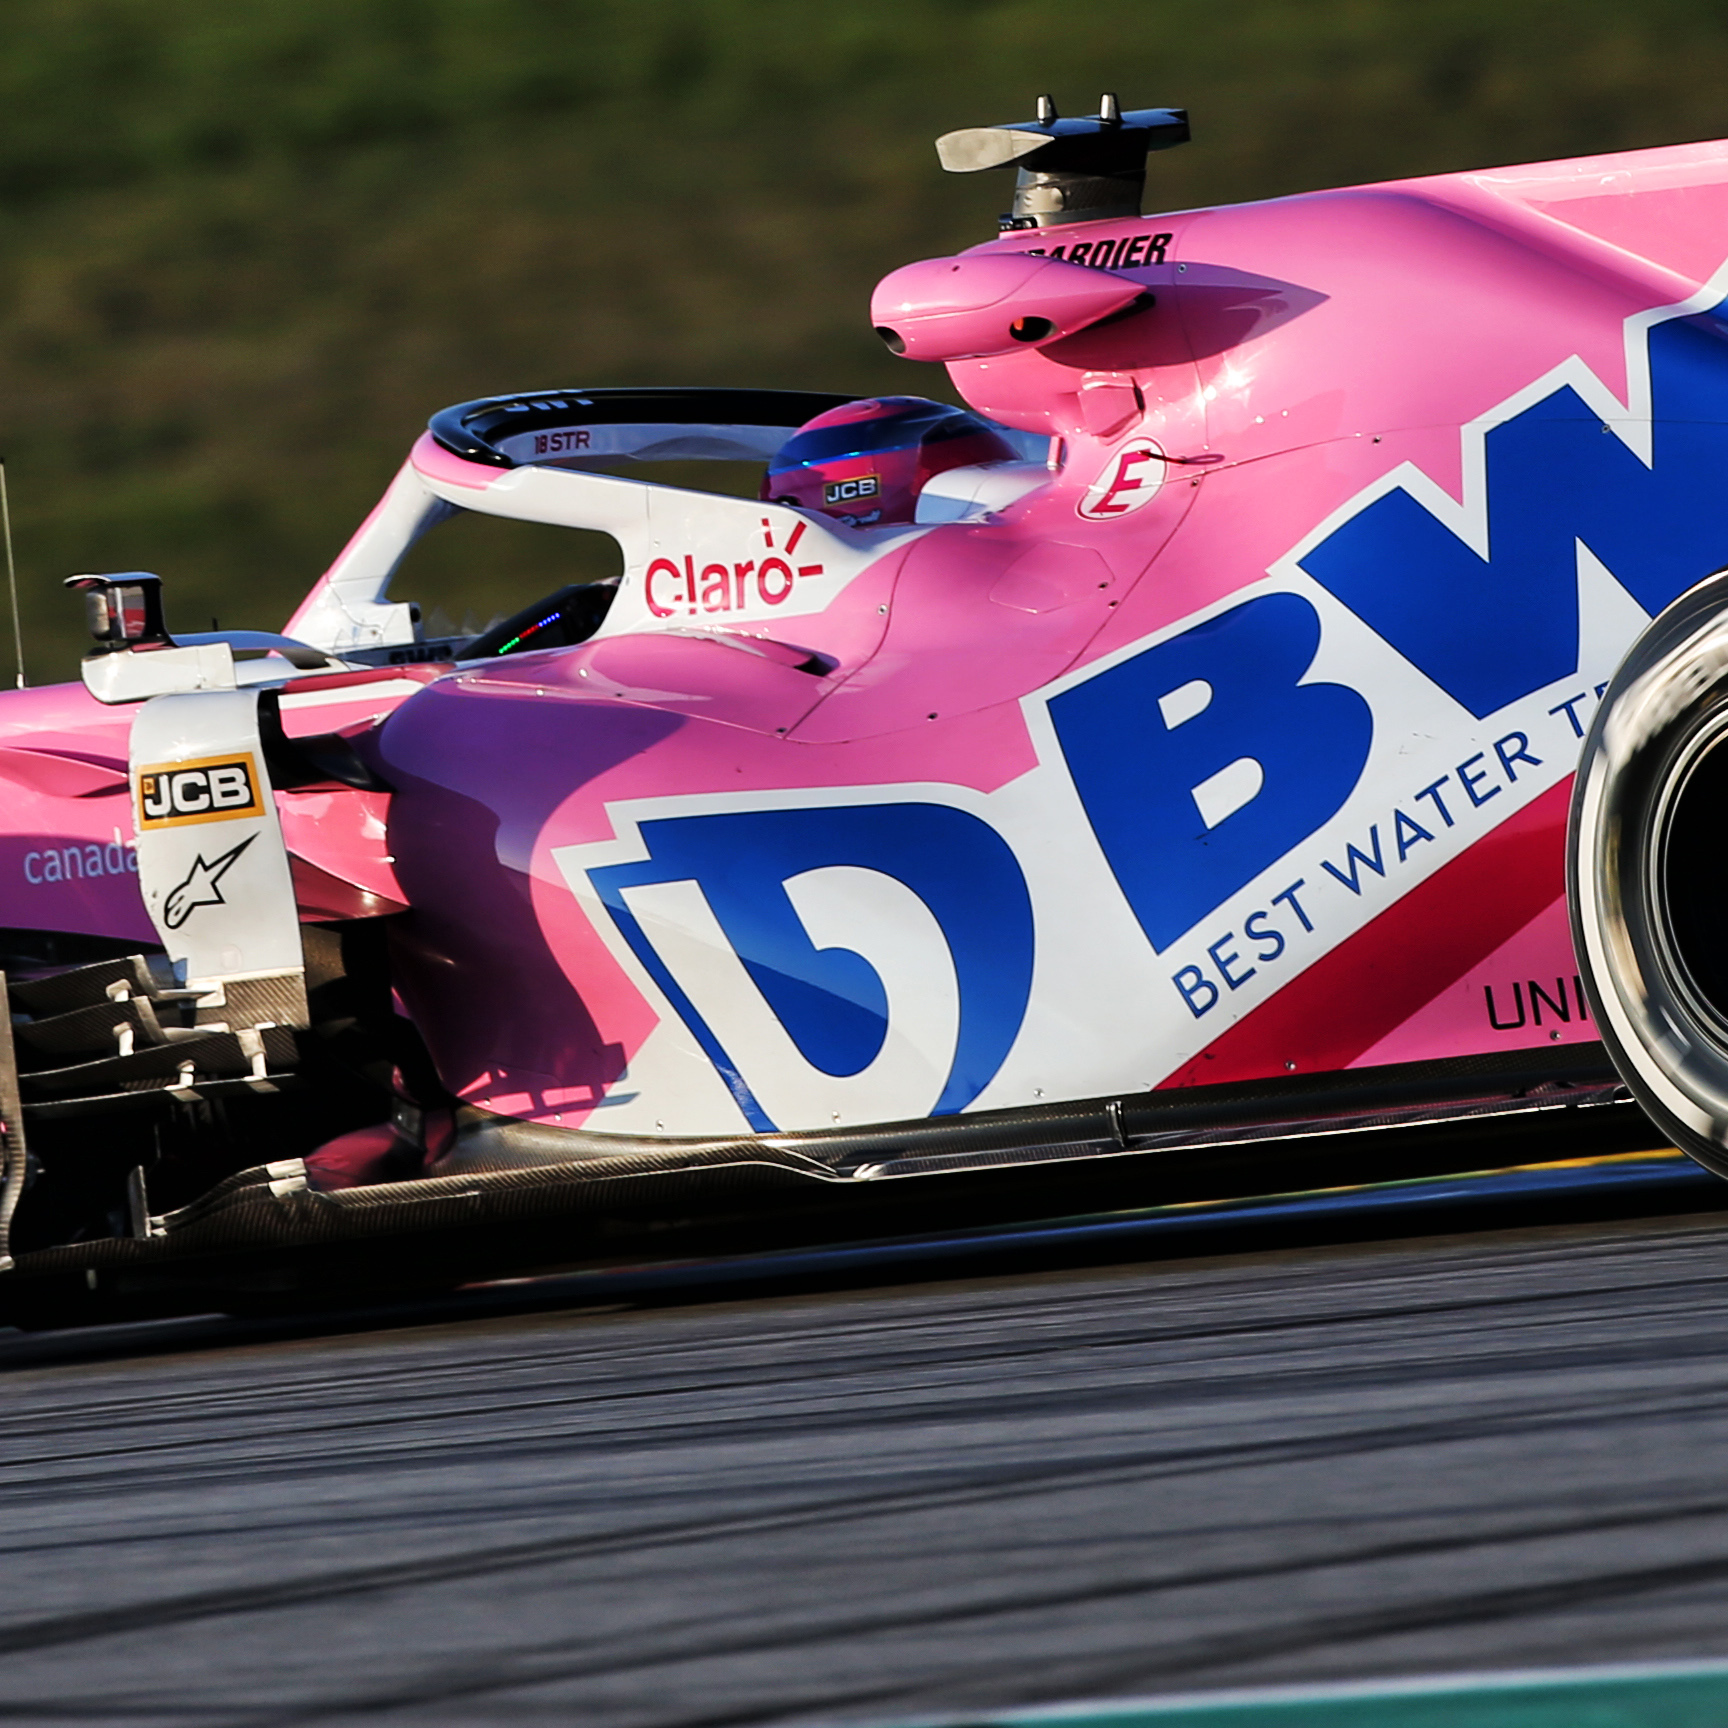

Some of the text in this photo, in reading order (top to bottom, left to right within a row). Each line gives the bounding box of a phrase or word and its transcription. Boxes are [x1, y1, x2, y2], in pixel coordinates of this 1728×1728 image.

[534, 430, 591, 455] 18 STR
[826, 478, 876, 503] JCB
[645, 554, 793, 618] Claro
[143, 767, 251, 816] JCB
[1172, 878, 1314, 1019] BEST
[1320, 731, 1543, 896] WATER
